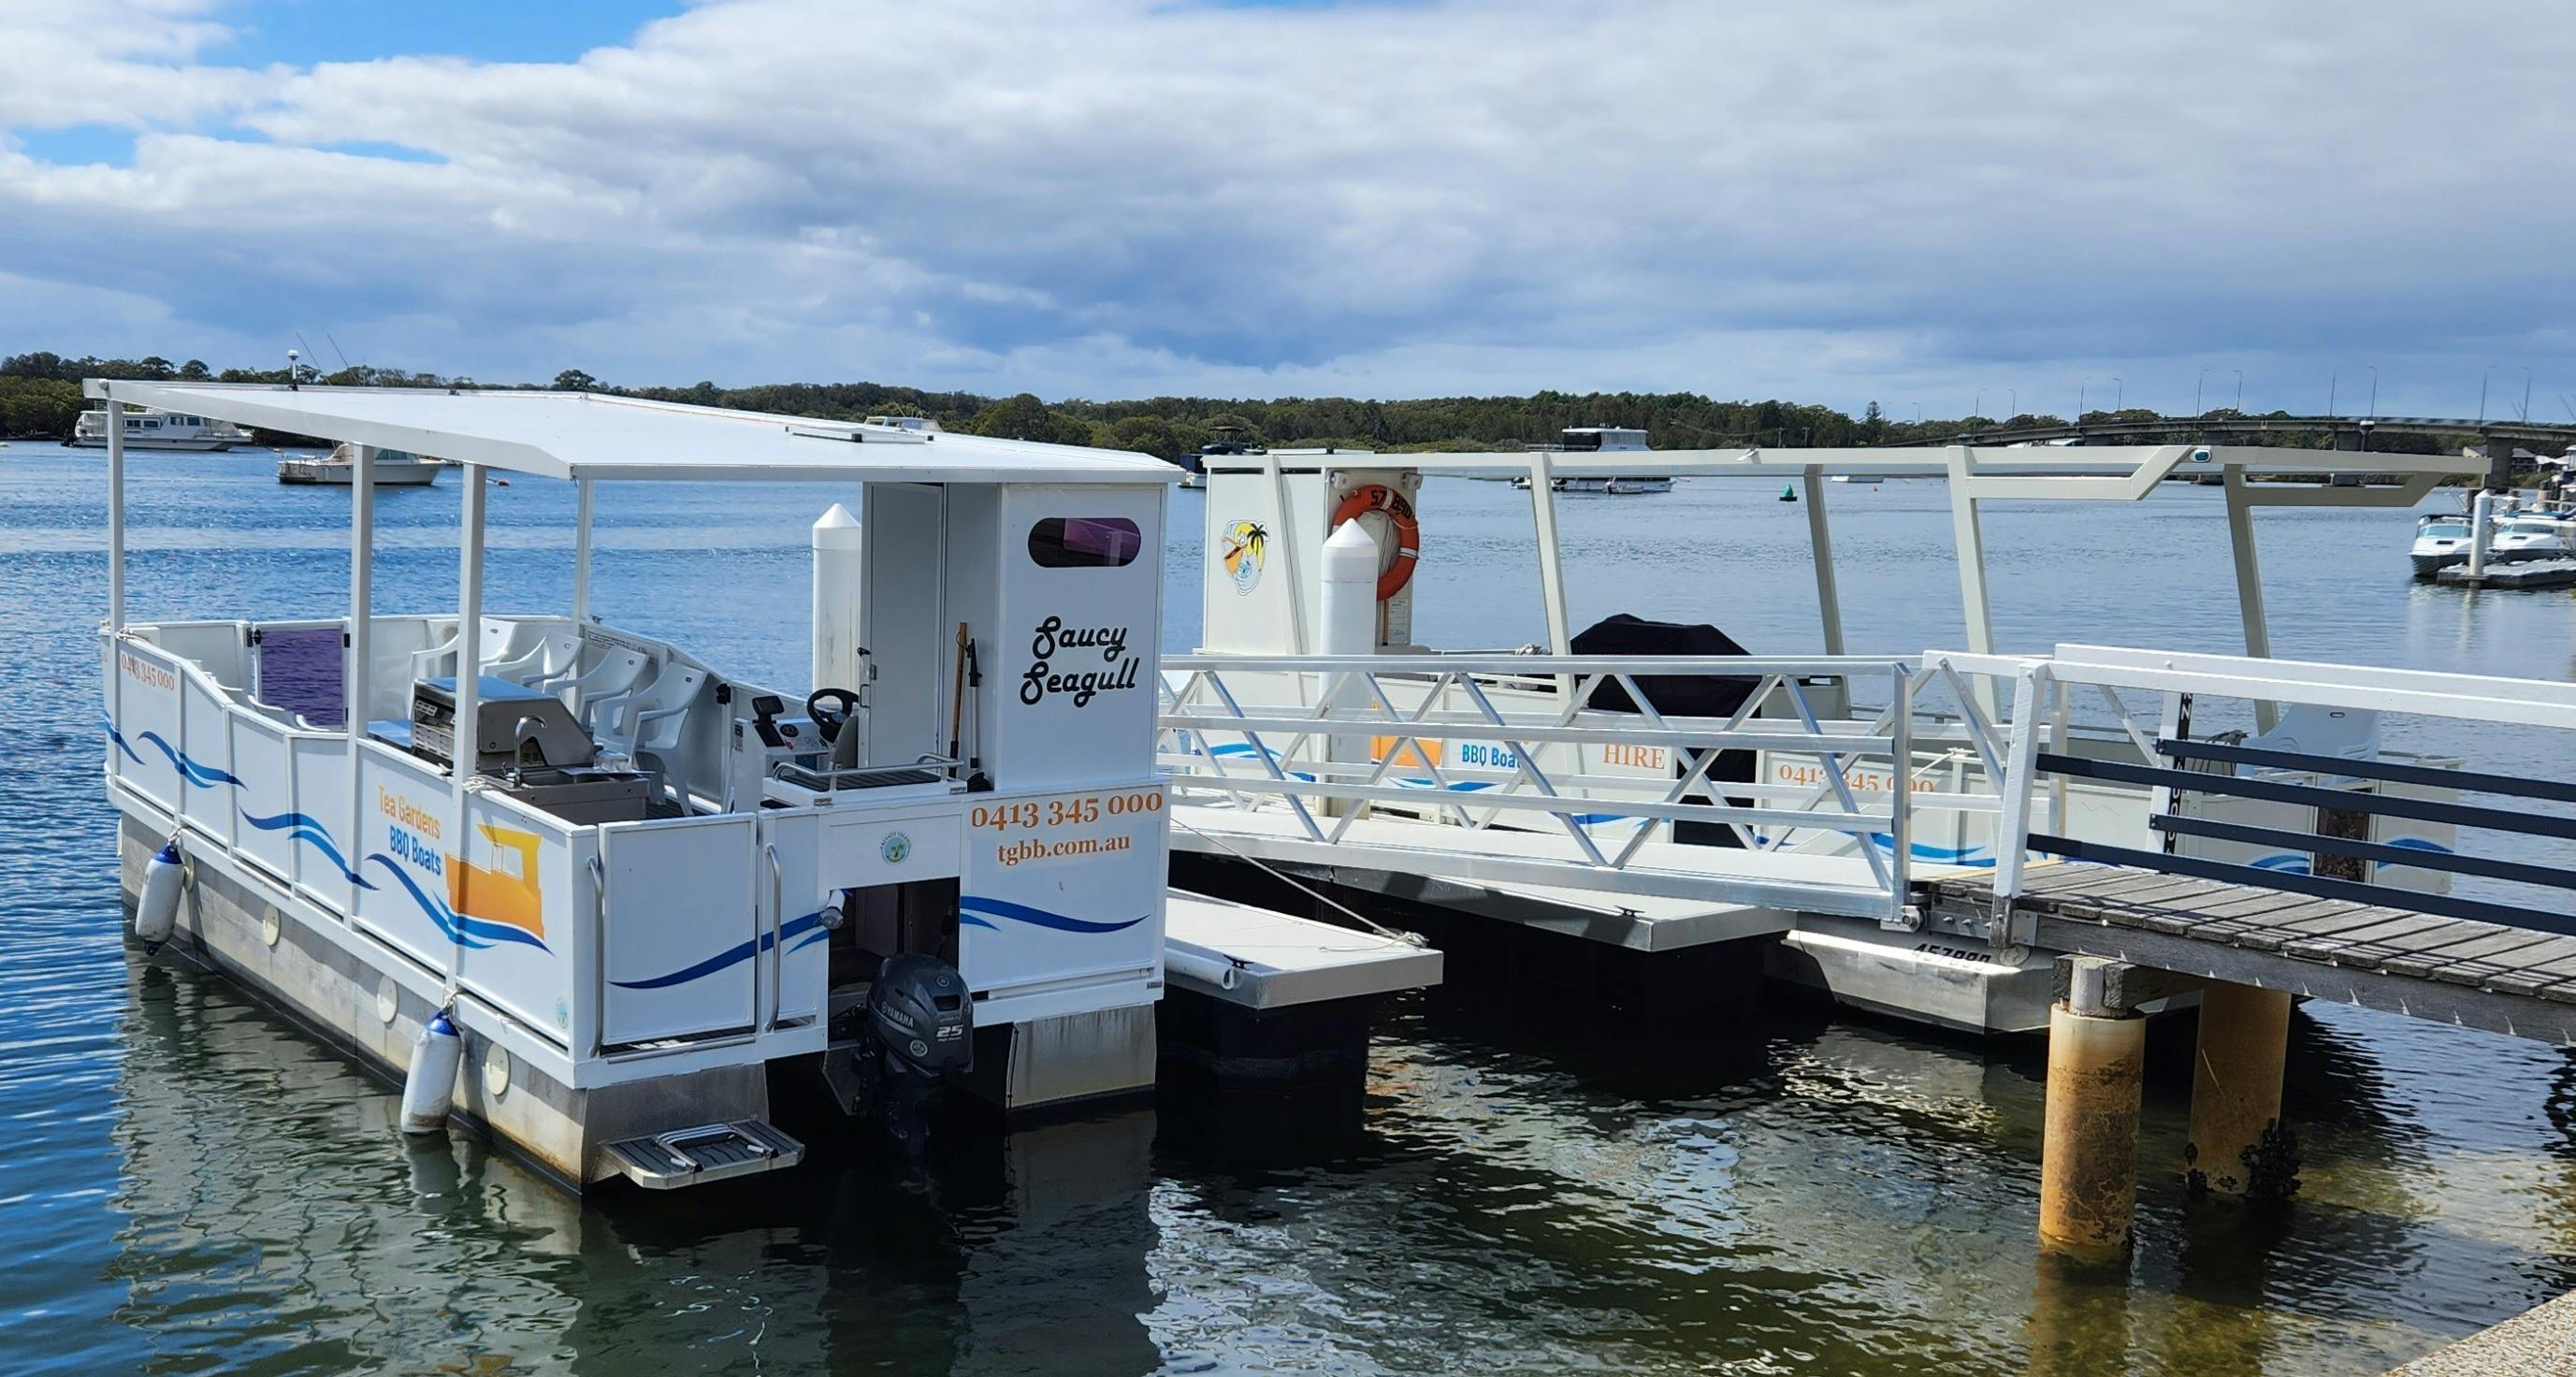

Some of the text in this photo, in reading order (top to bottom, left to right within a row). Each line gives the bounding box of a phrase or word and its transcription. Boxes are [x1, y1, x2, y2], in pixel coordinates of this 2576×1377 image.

[1033, 616, 1127, 662] Saucy
[1020, 657, 1139, 708] Seagull
[1462, 744, 1487, 767] BBQ
[1602, 743, 1665, 770] HIRE
[378, 784, 441, 840] Tea Gardens
[971, 792, 1163, 832] 0413 345 000
[389, 824, 441, 877] BBQ Boats
[997, 835, 1131, 866] tgbb.com.au
[888, 1007, 915, 1029] YAMAHA
[936, 1024, 964, 1038] 25
